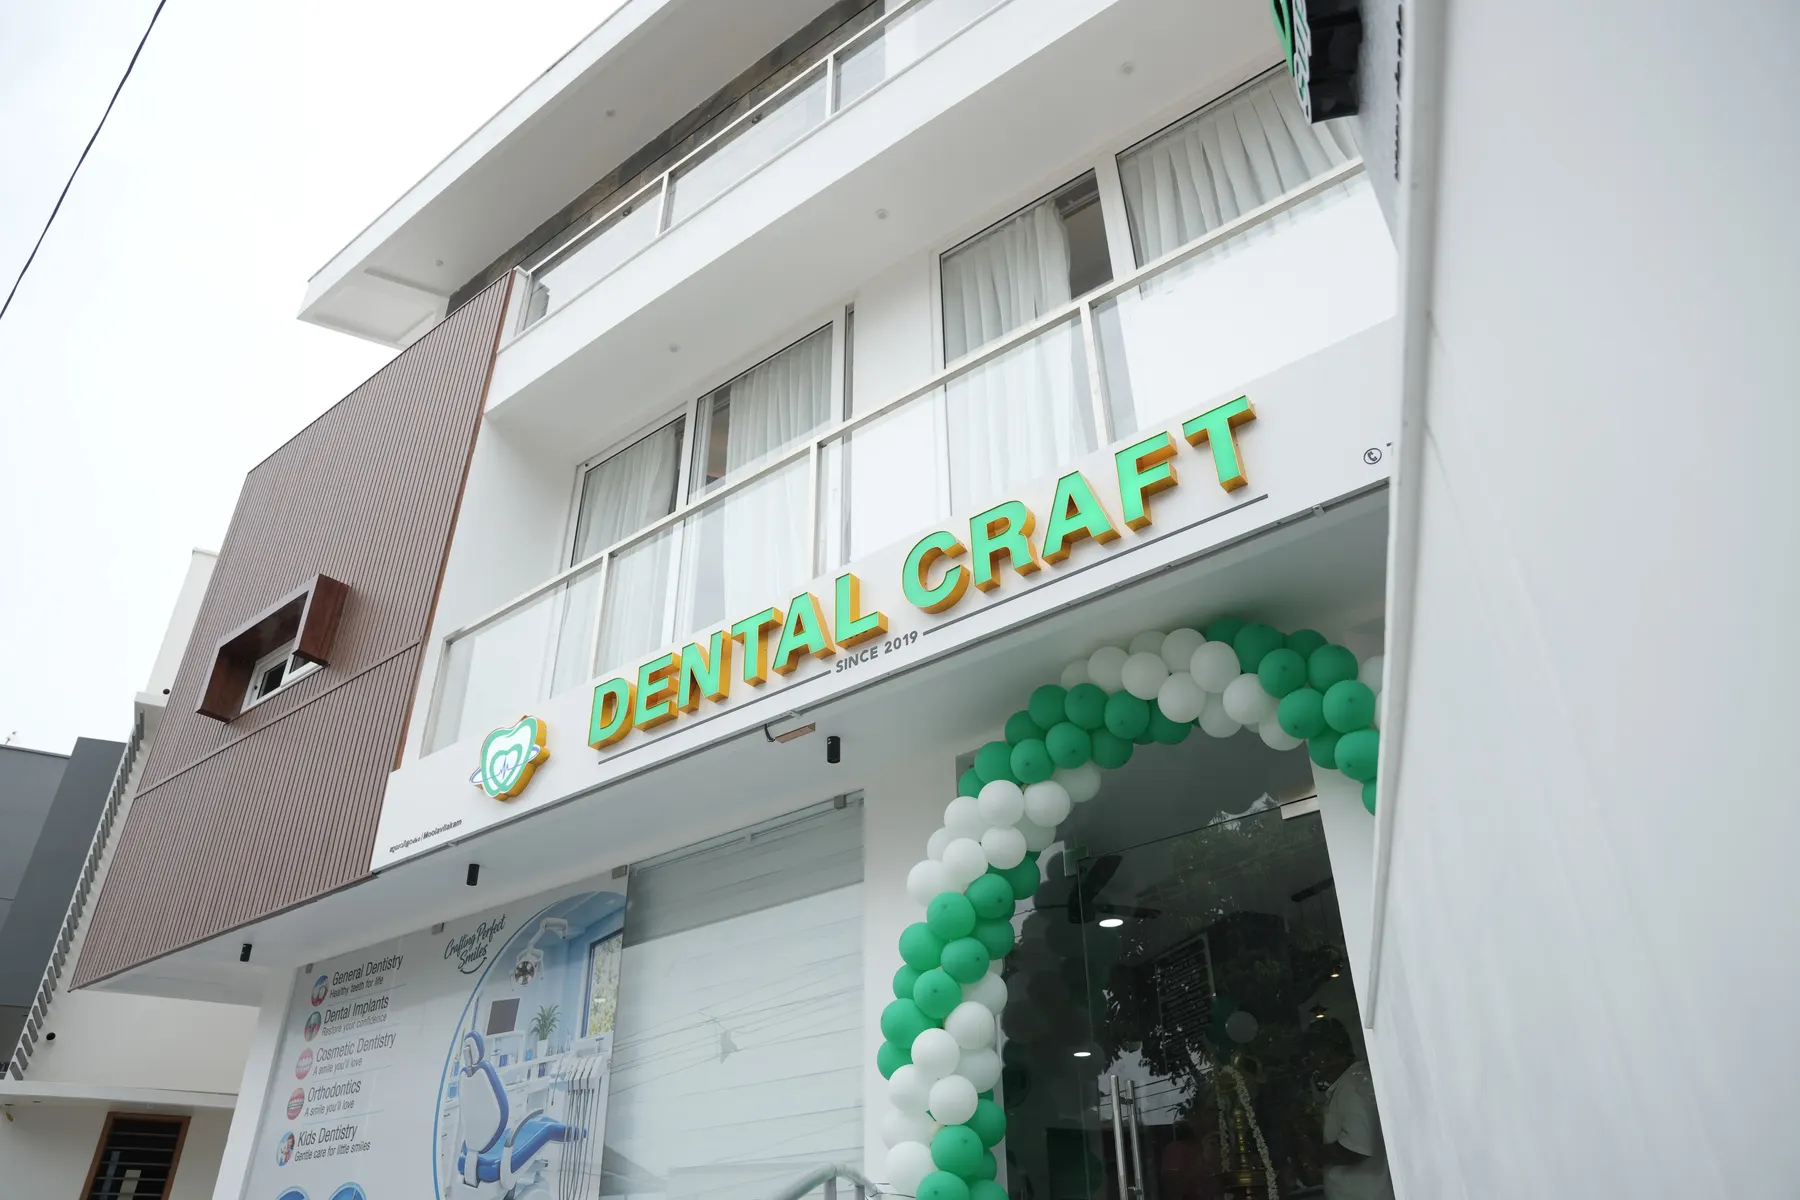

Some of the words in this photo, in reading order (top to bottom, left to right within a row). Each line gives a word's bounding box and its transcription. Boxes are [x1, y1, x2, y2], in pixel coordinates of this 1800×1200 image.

[588, 573, 888, 750] DENTAL
[902, 395, 1256, 614] CRAFT
[836, 646, 878, 673] SINCE
[885, 631, 918, 654] 2019
[444, 934, 476, 959] Crafting
[477, 914, 506, 943] Perfect
[458, 943, 488, 969] Smiles
[332, 964, 364, 986] General
[365, 955, 404, 977] Dentistry
[329, 987, 349, 999] Healthy
[350, 983, 365, 993] teeth
[365, 979, 374, 988] for
[374, 976, 384, 986] life
[324, 1004, 351, 1024] Dental
[353, 996, 389, 1018] Implants
[321, 1025, 342, 1036] Restore
[342, 1021, 356, 1033] your
[356, 1014, 387, 1029] confidence
[316, 1041, 355, 1062] Cosmetic
[356, 1032, 396, 1053] Dentistry
[312, 1066, 318, 1076] A
[318, 1063, 333, 1075] smile
[350, 1058, 362, 1068] love
[307, 1079, 361, 1103] Orthodontics
[304, 1107, 309, 1116] A
[310, 1104, 325, 1116] smile
[342, 1099, 354, 1110] love
[297, 1130, 317, 1147] Kids
[318, 1124, 358, 1143] Dentistry
[294, 1150, 312, 1162] Gentle
[313, 1148, 327, 1158] care
[327, 1145, 336, 1157] for
[336, 1143, 350, 1155] little
[350, 1141, 371, 1153] smiles
